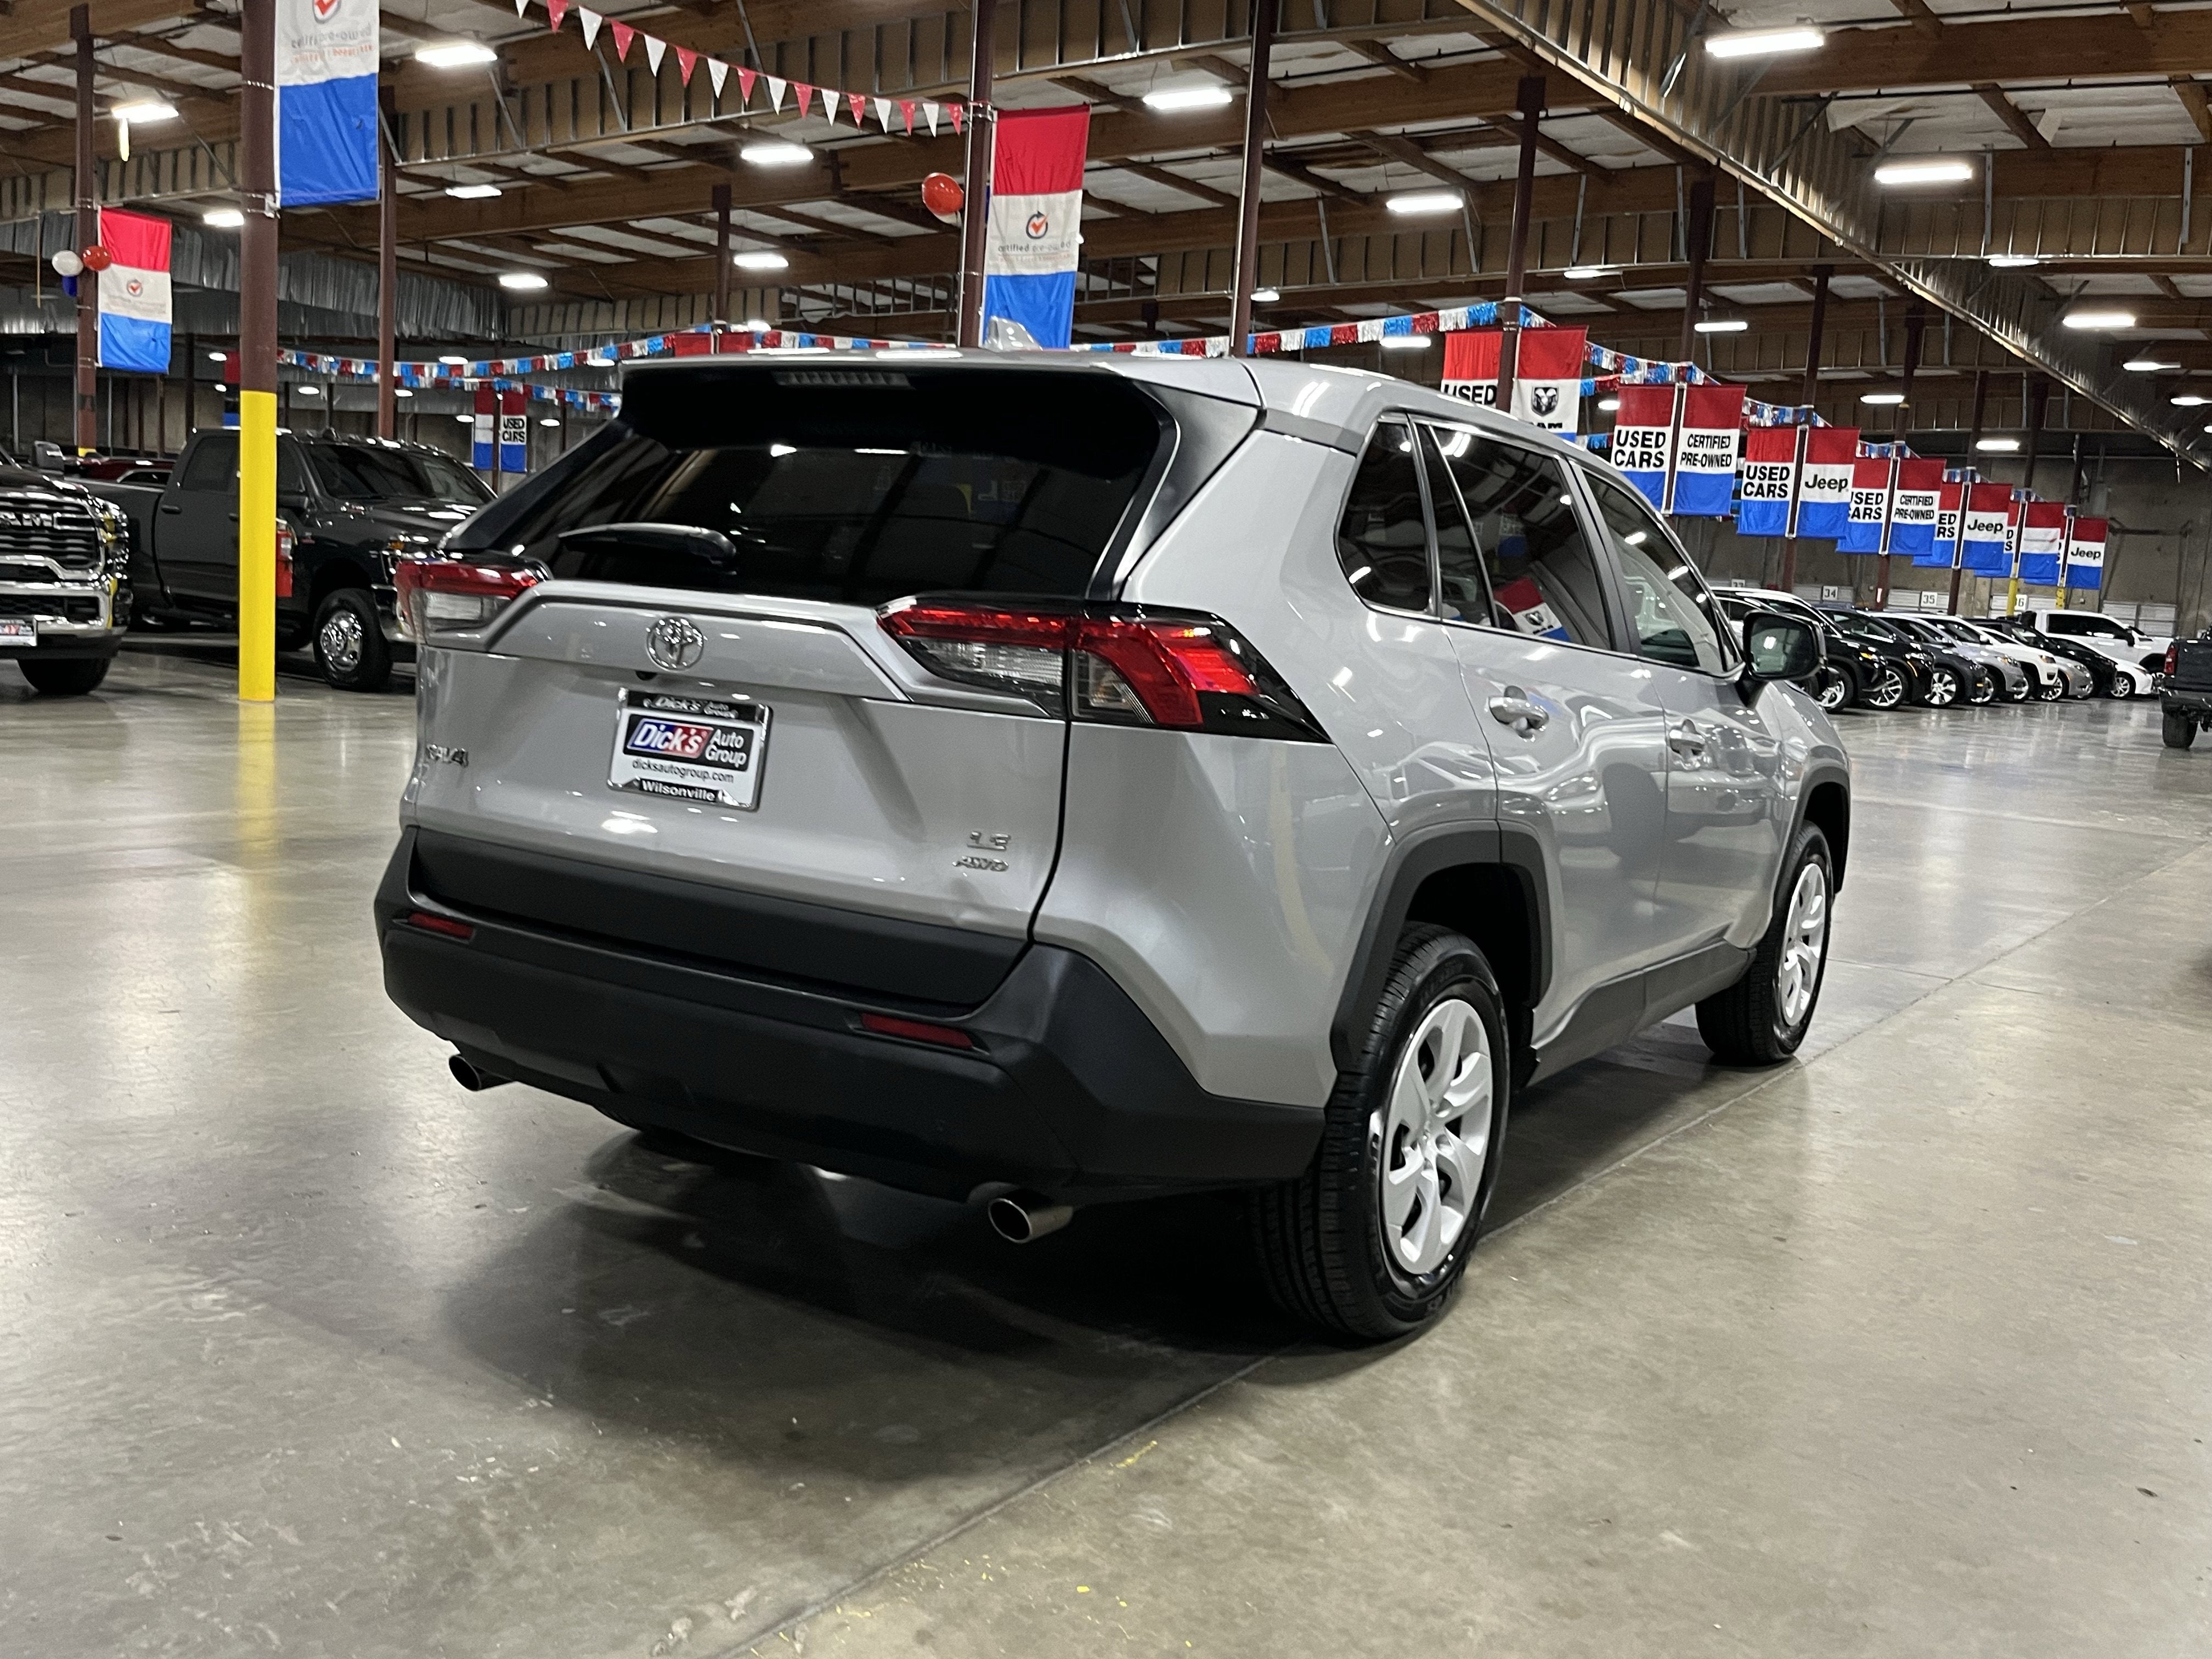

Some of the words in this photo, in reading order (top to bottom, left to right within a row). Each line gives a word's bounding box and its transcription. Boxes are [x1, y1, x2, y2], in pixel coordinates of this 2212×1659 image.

[1616, 430, 1666, 449] USED
[1687, 433, 1731, 449] CERTIFIED
[1614, 449, 1665, 468] CARS
[1680, 452, 1732, 467] PRE-OWNED
[1745, 465, 1790, 481] USED
[1743, 482, 1788, 498] CARS
[1804, 474, 1848, 493] Jeep
[1900, 495, 1933, 506] CERTIFIED
[1849, 507, 1882, 520] ARS
[1894, 507, 1934, 520] PRE-OWNED
[1938, 514, 1957, 525] ED
[1937, 526, 1955, 538] RS
[1967, 519, 2004, 534] Jeep
[2071, 547, 2101, 560] Jeep
[1824, 589, 1837, 598] 34
[1922, 595, 1936, 604] 35
[2016, 597, 2024, 607] 6
[634, 723, 703, 754] Dick's
[710, 729, 744, 749] Auto
[705, 744, 747, 768] Group
[632, 758, 734, 783] dicksautogroup.com
[641, 780, 715, 802] Wilsonville
